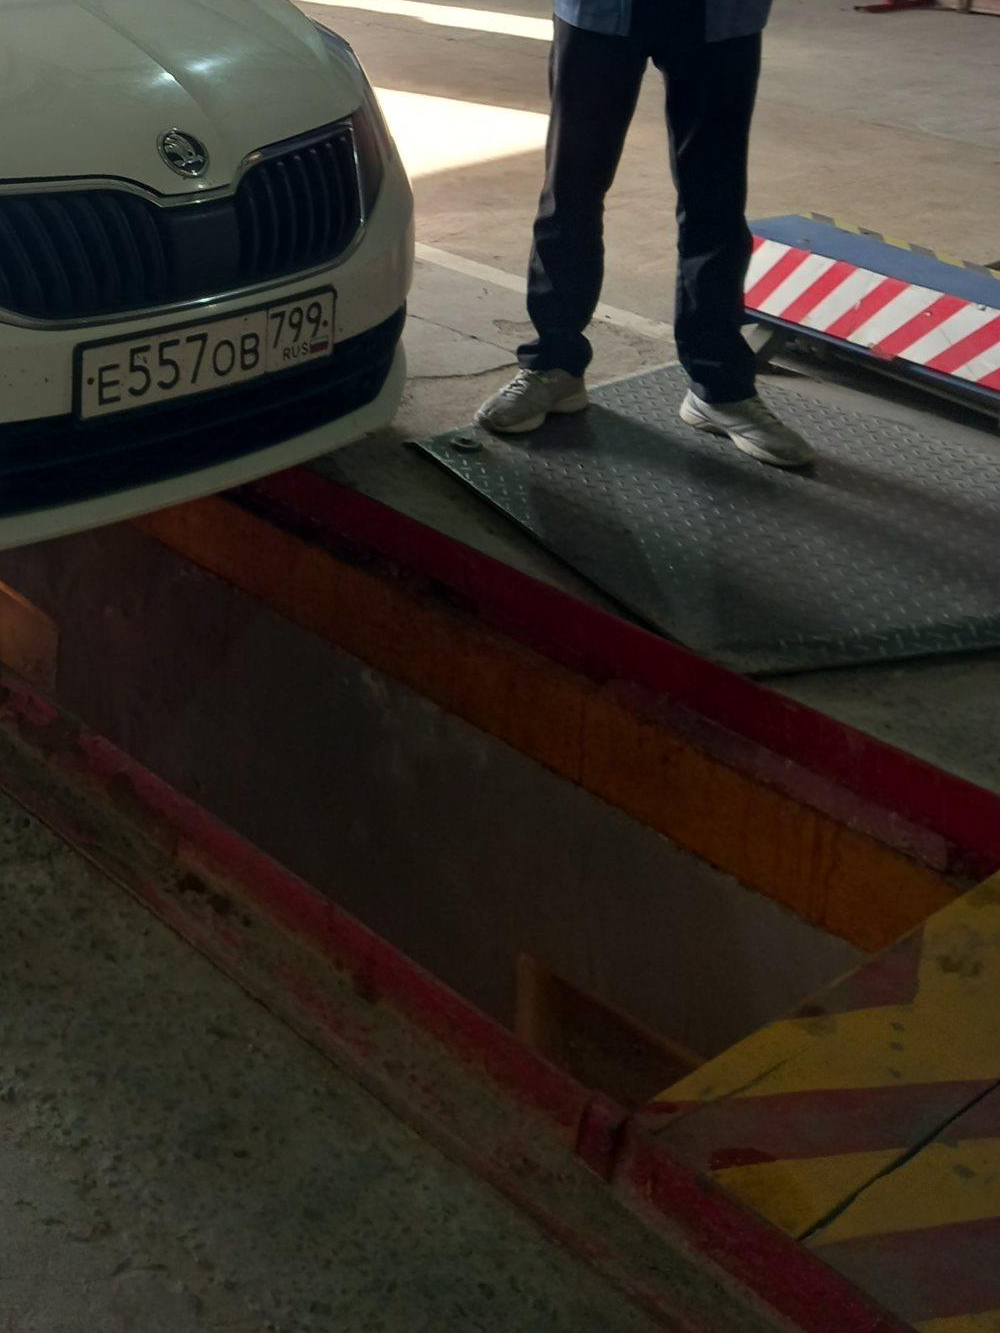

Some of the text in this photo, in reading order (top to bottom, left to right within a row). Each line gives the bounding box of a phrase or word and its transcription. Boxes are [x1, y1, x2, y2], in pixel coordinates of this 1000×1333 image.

[98, 302, 323, 406] E557OB 799
[282, 338, 310, 361] RUS
